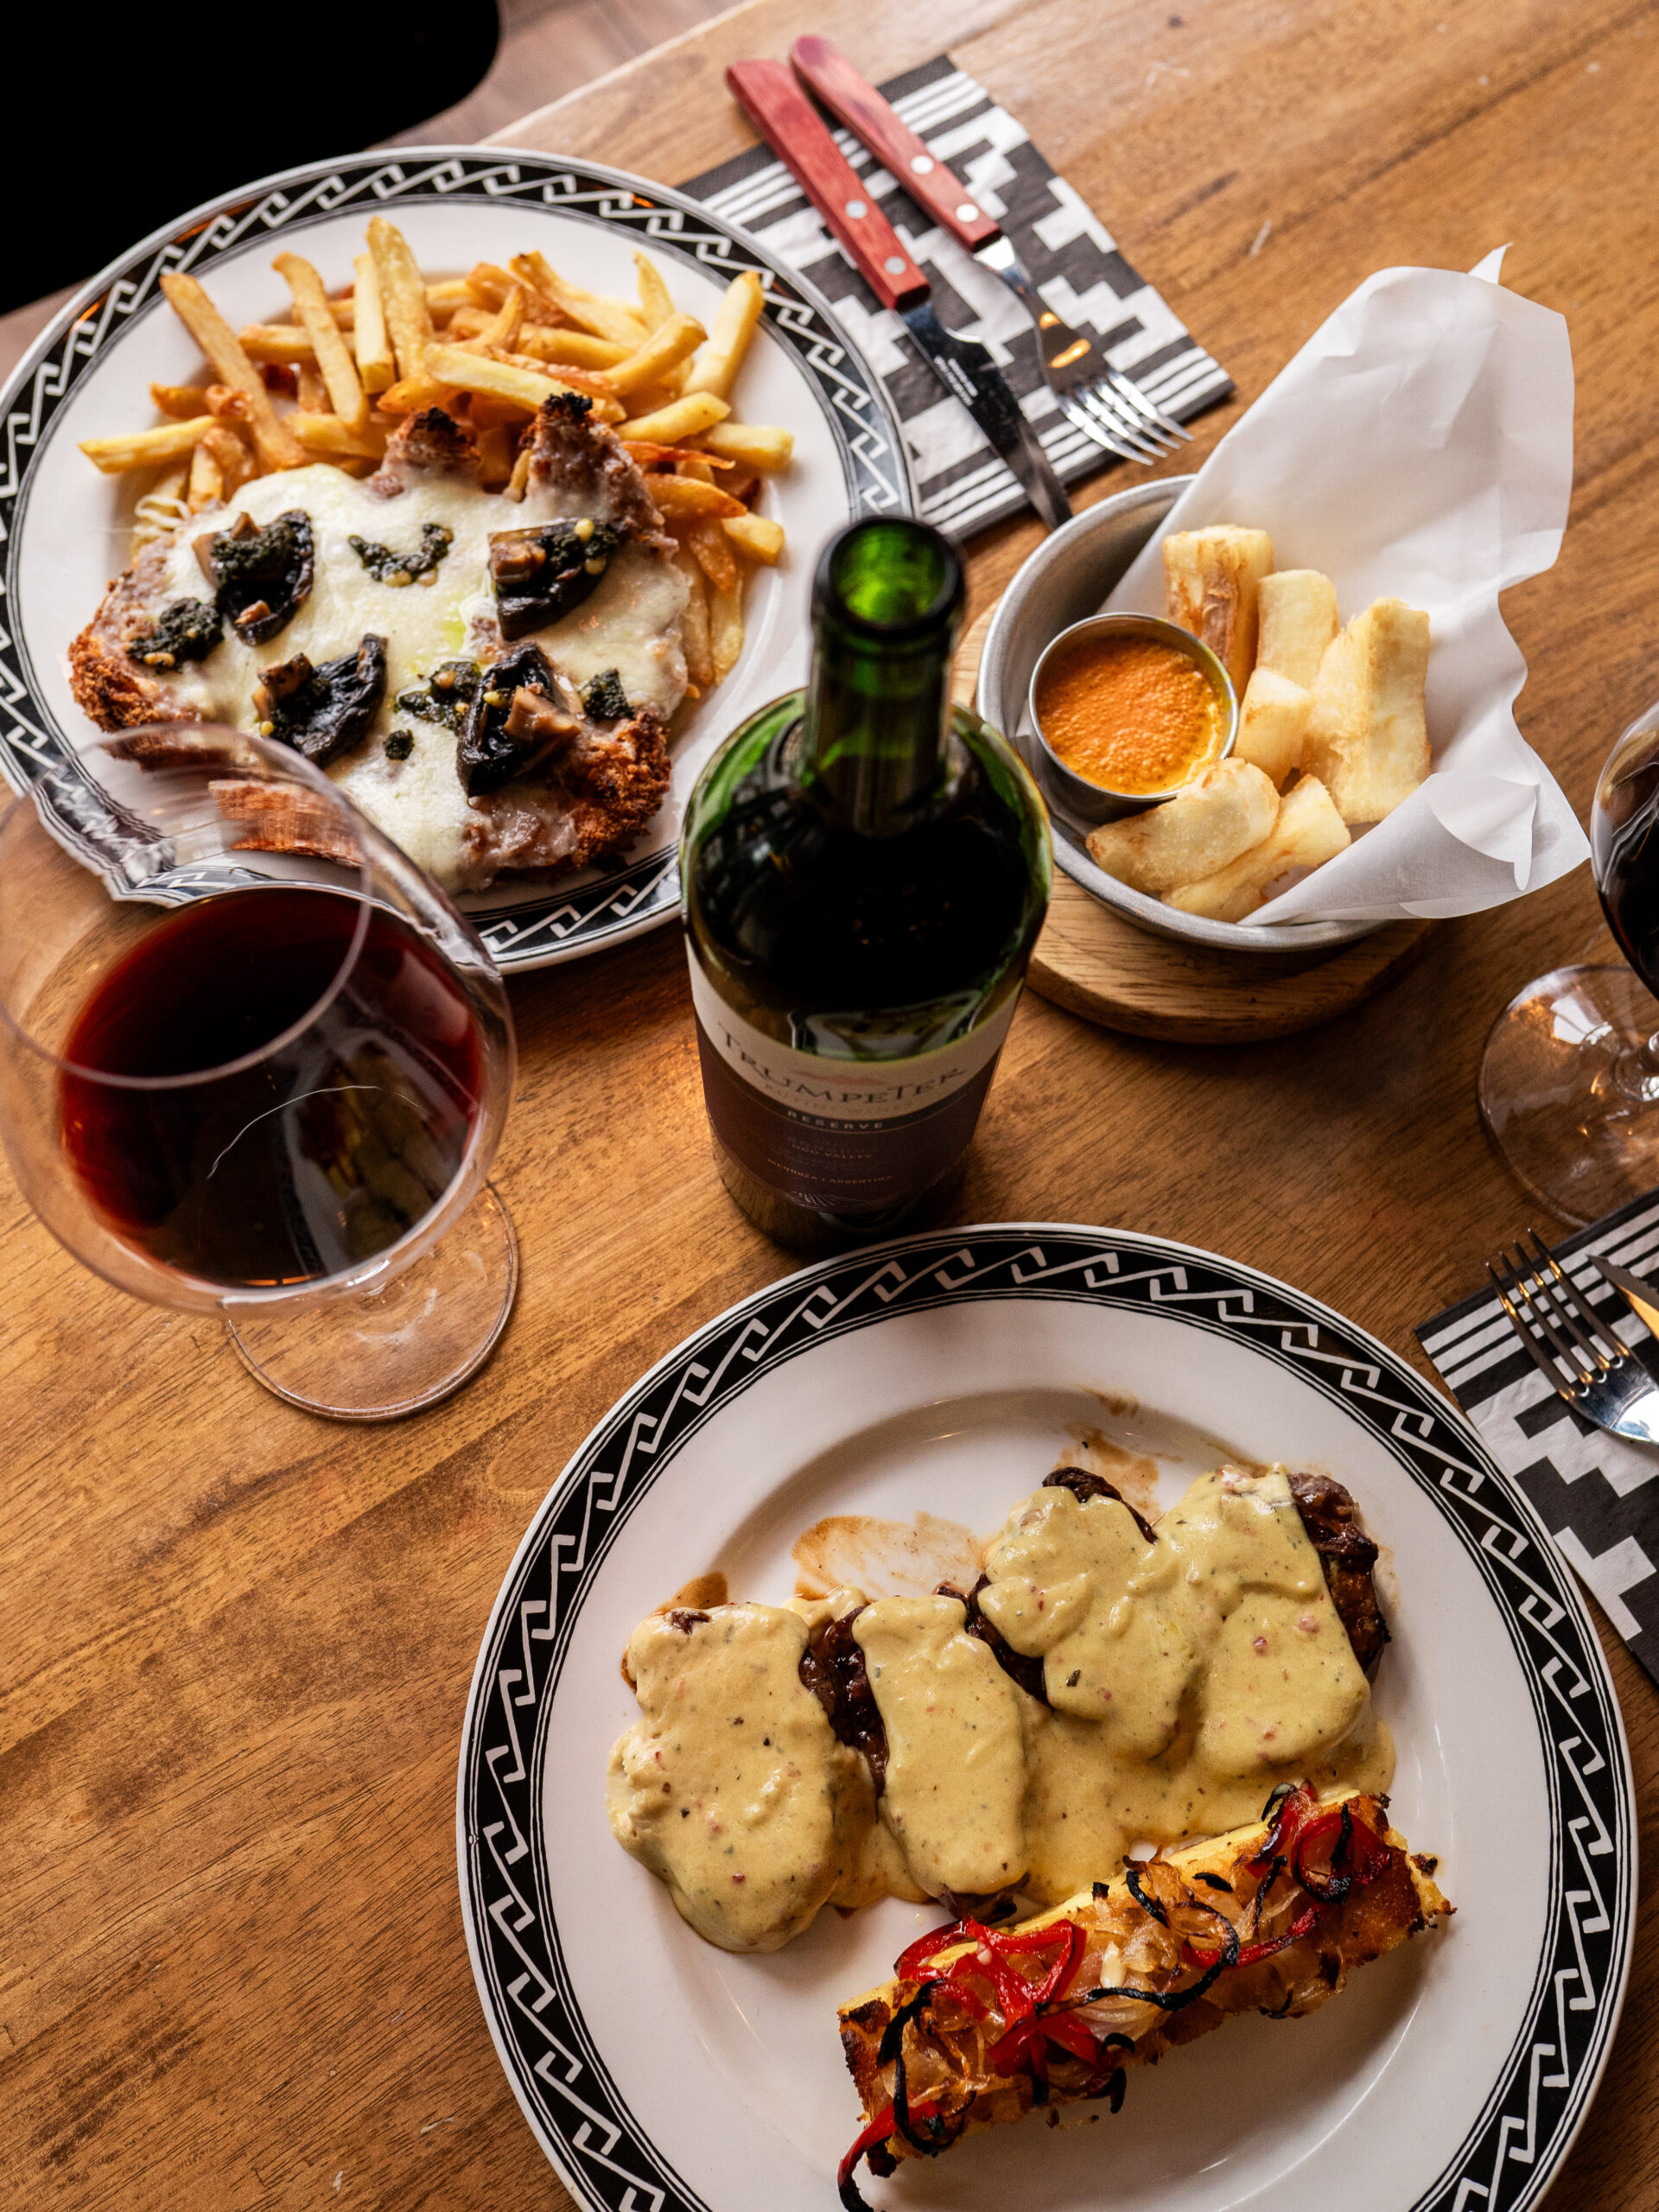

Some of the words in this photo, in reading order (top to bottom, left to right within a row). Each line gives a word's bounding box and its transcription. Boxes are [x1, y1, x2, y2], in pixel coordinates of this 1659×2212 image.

[718, 1021, 965, 1103] TRUMPETER
[787, 1110, 884, 1129] RESERVE
[767, 1158, 818, 1180] MENDOZA
[829, 1175, 893, 1184] ARGENTINA
